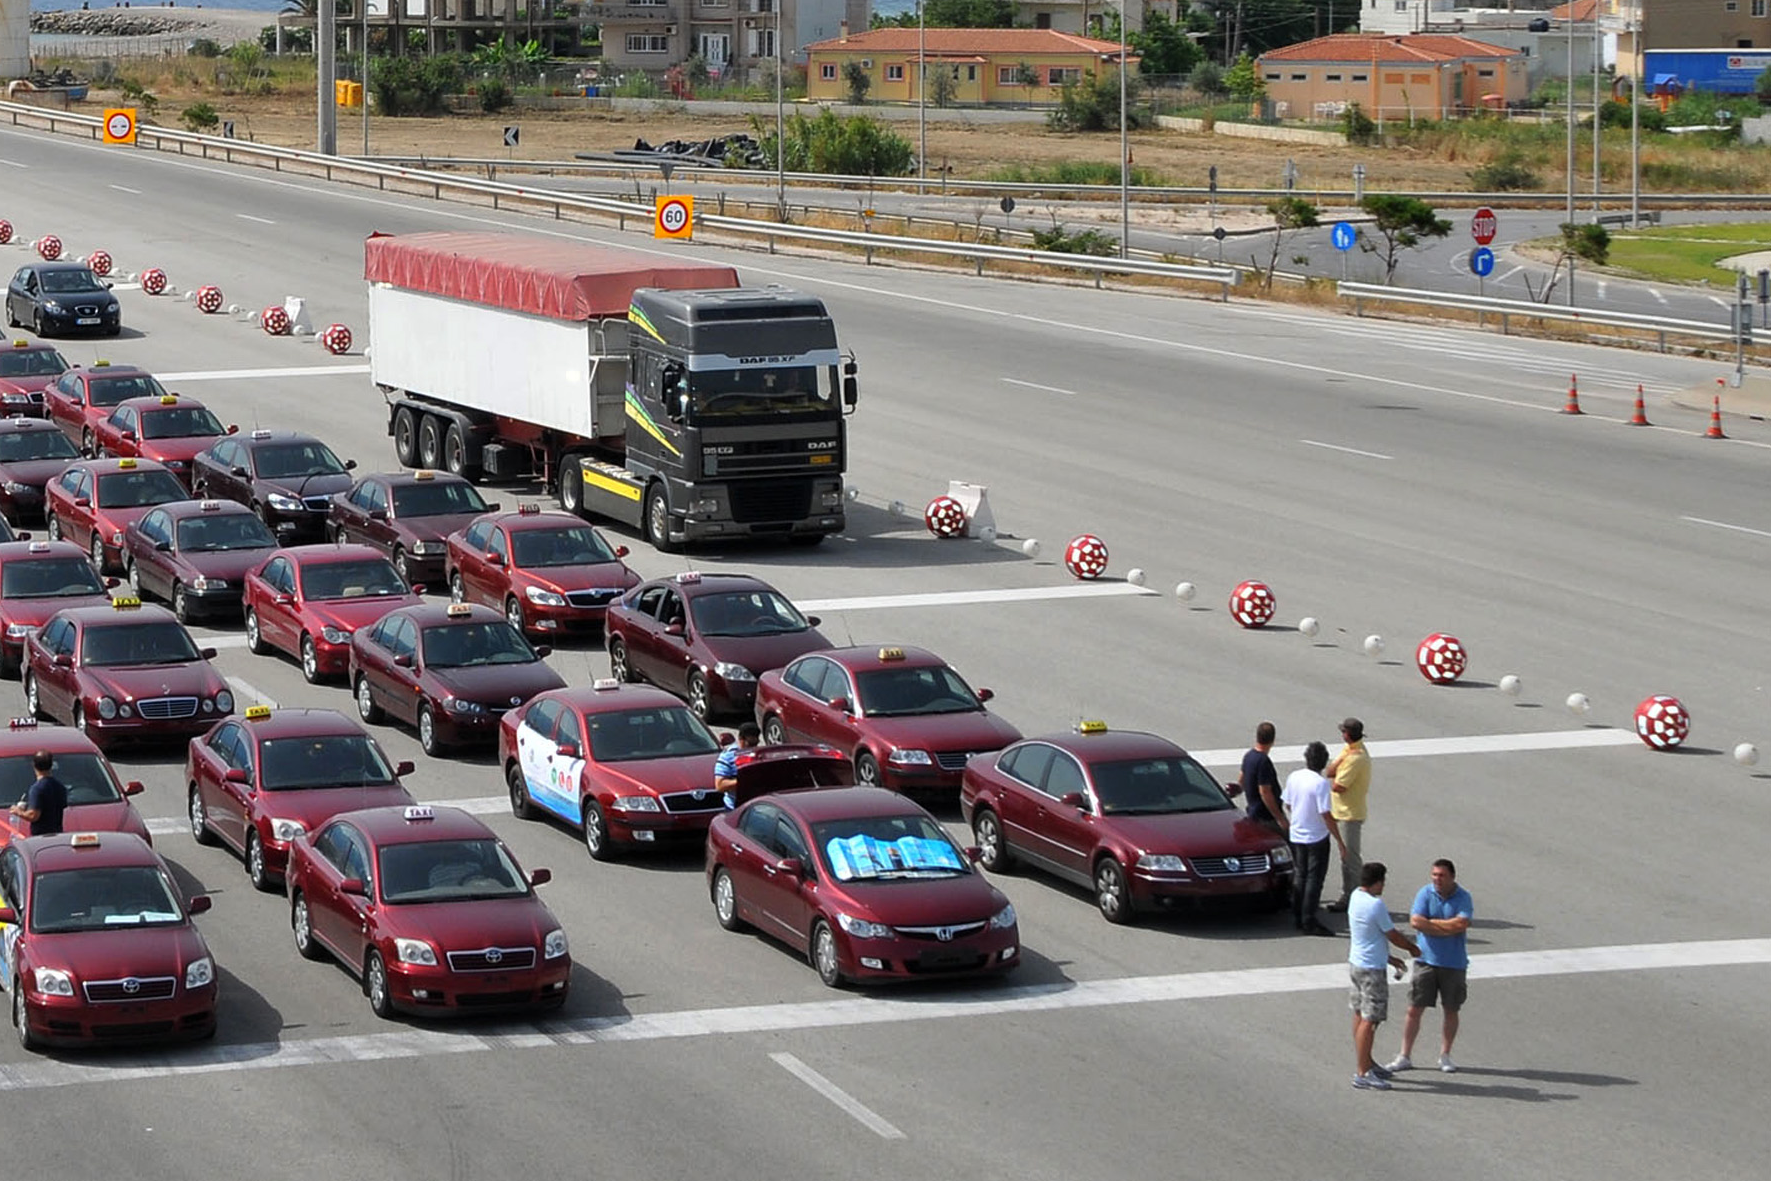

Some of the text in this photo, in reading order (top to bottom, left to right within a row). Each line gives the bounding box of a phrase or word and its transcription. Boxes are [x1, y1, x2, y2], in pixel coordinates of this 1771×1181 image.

[665, 210, 683, 223] 60
[1472, 218, 1496, 237] STOP
[808, 441, 837, 449] DAF
[250, 707, 269, 715] TAXI
[14, 717, 37, 726] TAXI
[410, 809, 433, 817] TAXI
